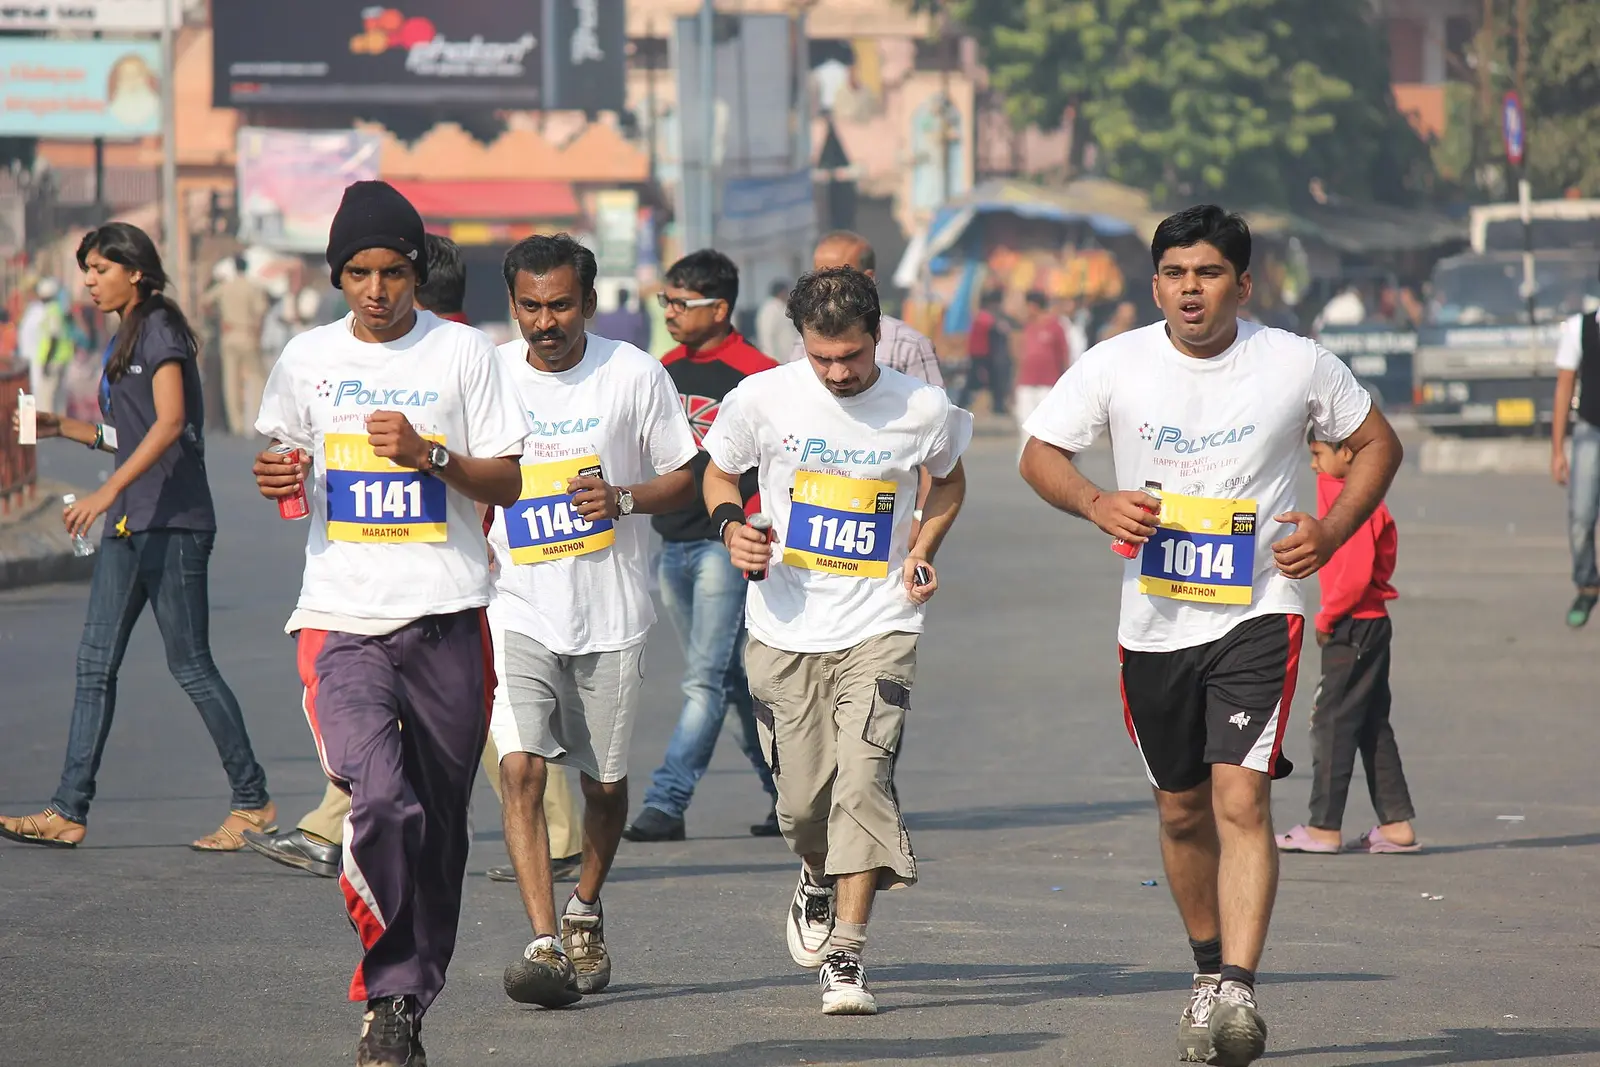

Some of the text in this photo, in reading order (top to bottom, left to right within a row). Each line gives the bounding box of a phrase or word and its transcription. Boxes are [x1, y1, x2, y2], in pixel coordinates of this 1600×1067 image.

[333, 380, 439, 407] POLYCAP
[332, 413, 360, 423] HAPPY
[1154, 424, 1255, 454] POLYCAP
[534, 442, 560, 451] HEART
[534, 447, 588, 458] HEALTHY LIFE
[800, 438, 892, 464] POLYCAP
[1153, 456, 1209, 469] HAPPY HEART
[1179, 457, 1239, 478] HEALTHY LIFE
[350, 480, 421, 518] 1141
[362, 528, 410, 537] MARATHON
[1234, 522, 1253, 532] 2011
[808, 514, 876, 555] 1145
[542, 542, 585, 555] MARATHON
[816, 557, 858, 571] MARATHON
[1161, 538, 1235, 580] 1014
[1171, 584, 1216, 598] MARATHON
